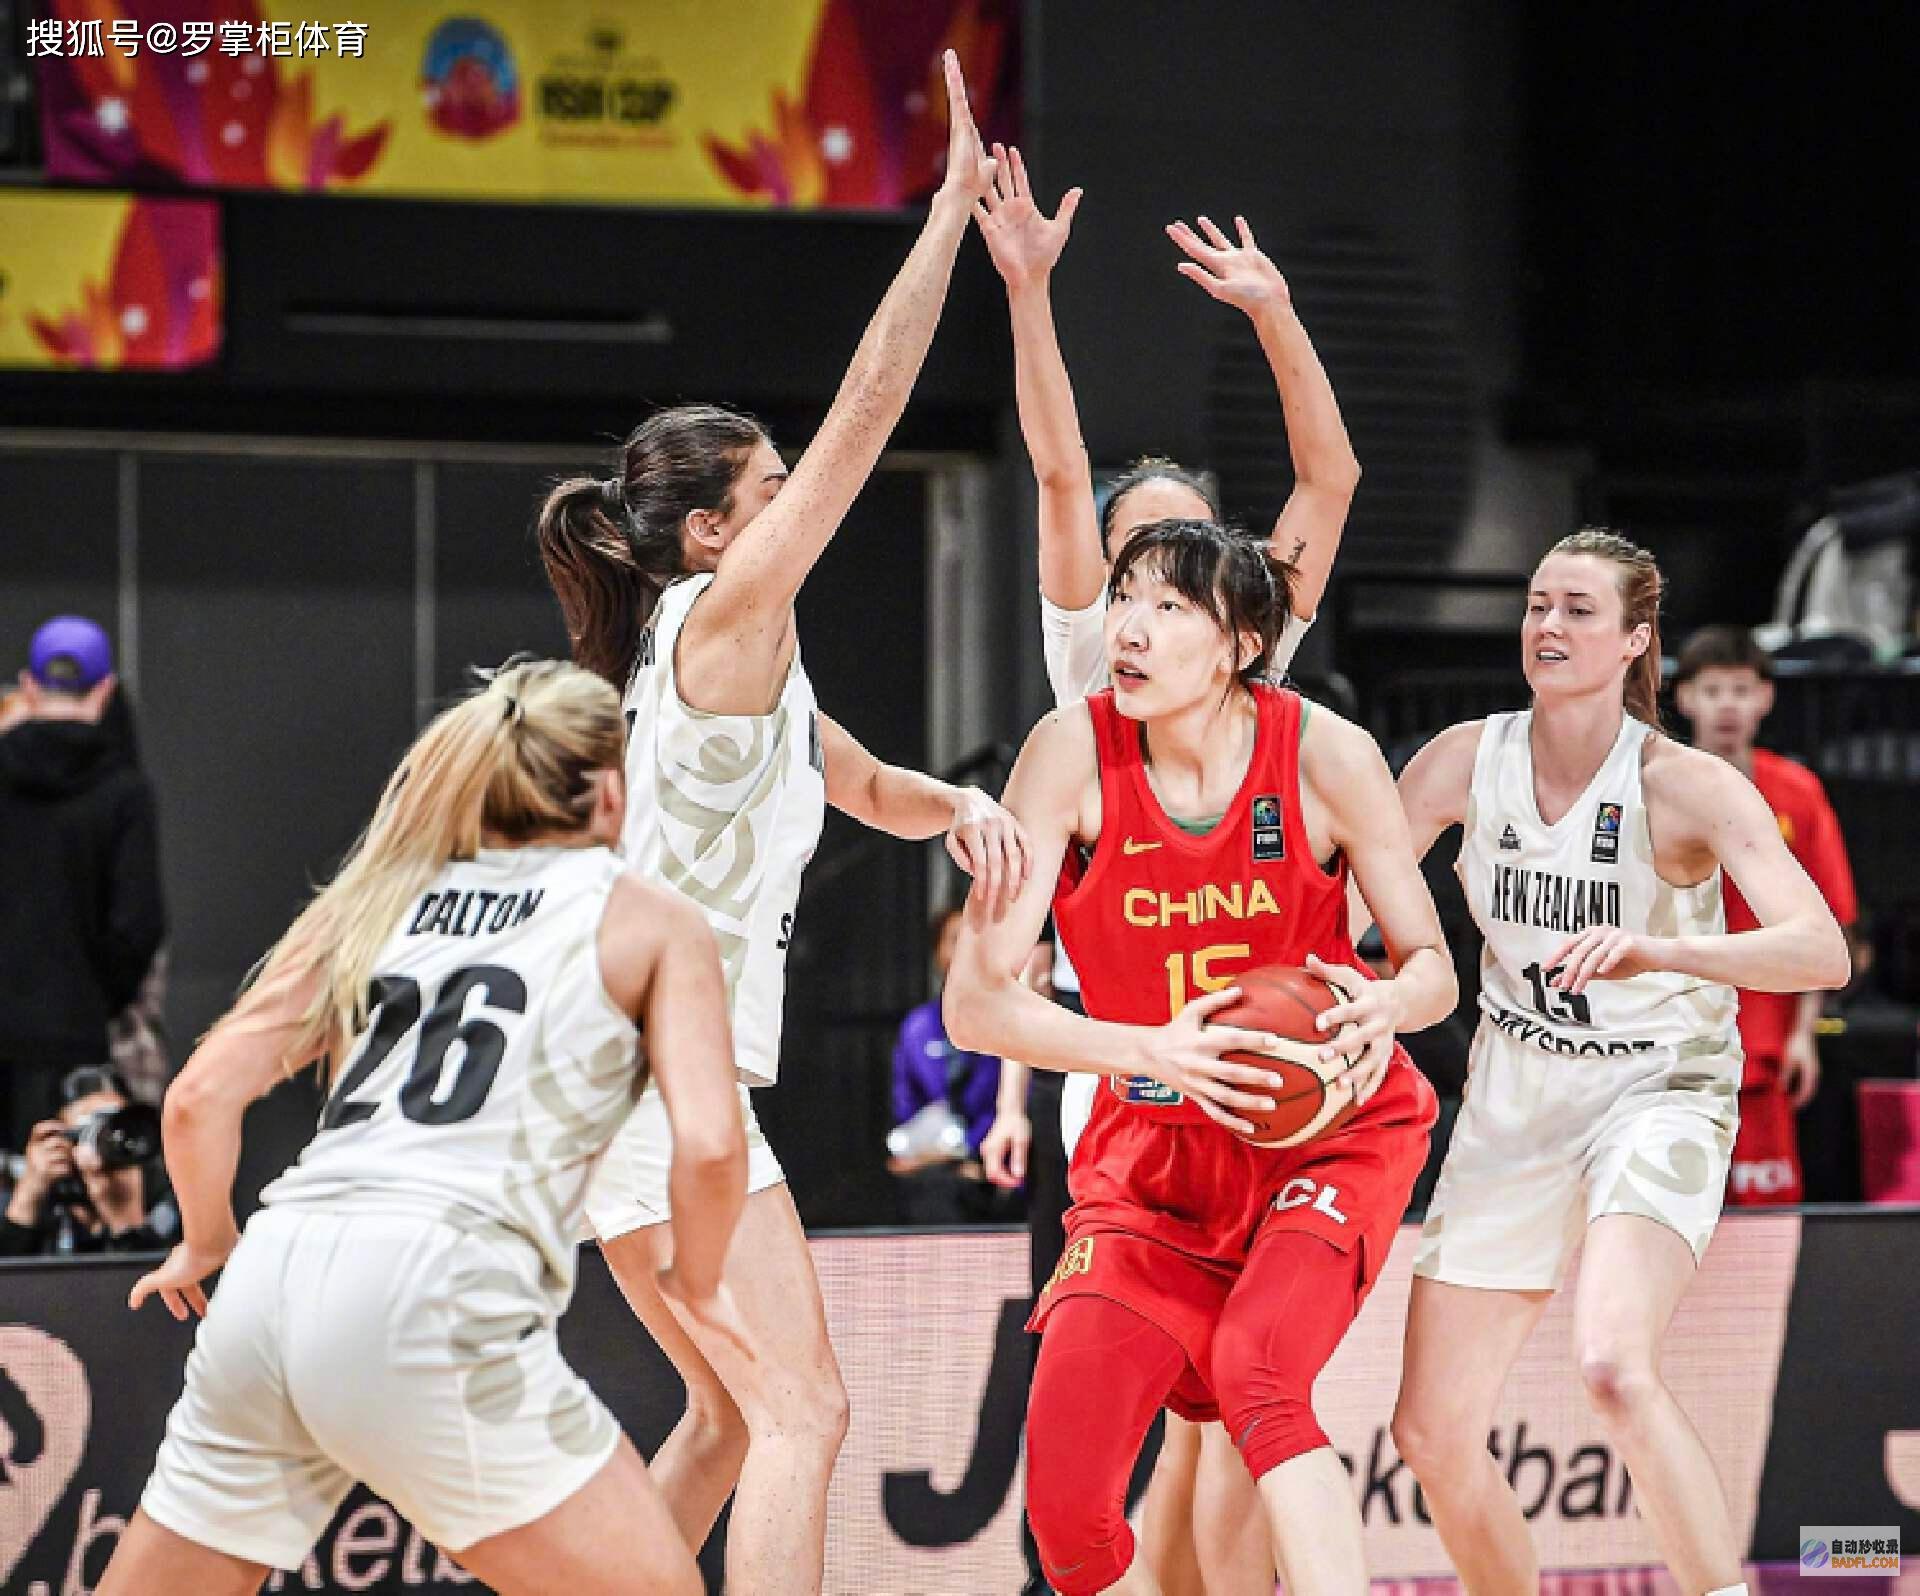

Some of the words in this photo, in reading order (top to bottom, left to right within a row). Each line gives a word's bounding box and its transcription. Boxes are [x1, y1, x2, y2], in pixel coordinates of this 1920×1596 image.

[1123, 879, 1281, 927] CHINA
[1491, 863, 1531, 924] NEW
[1532, 871, 1621, 934] ZEALAND
[320, 963, 528, 1125] 26
[1272, 1177, 1348, 1224] CL
